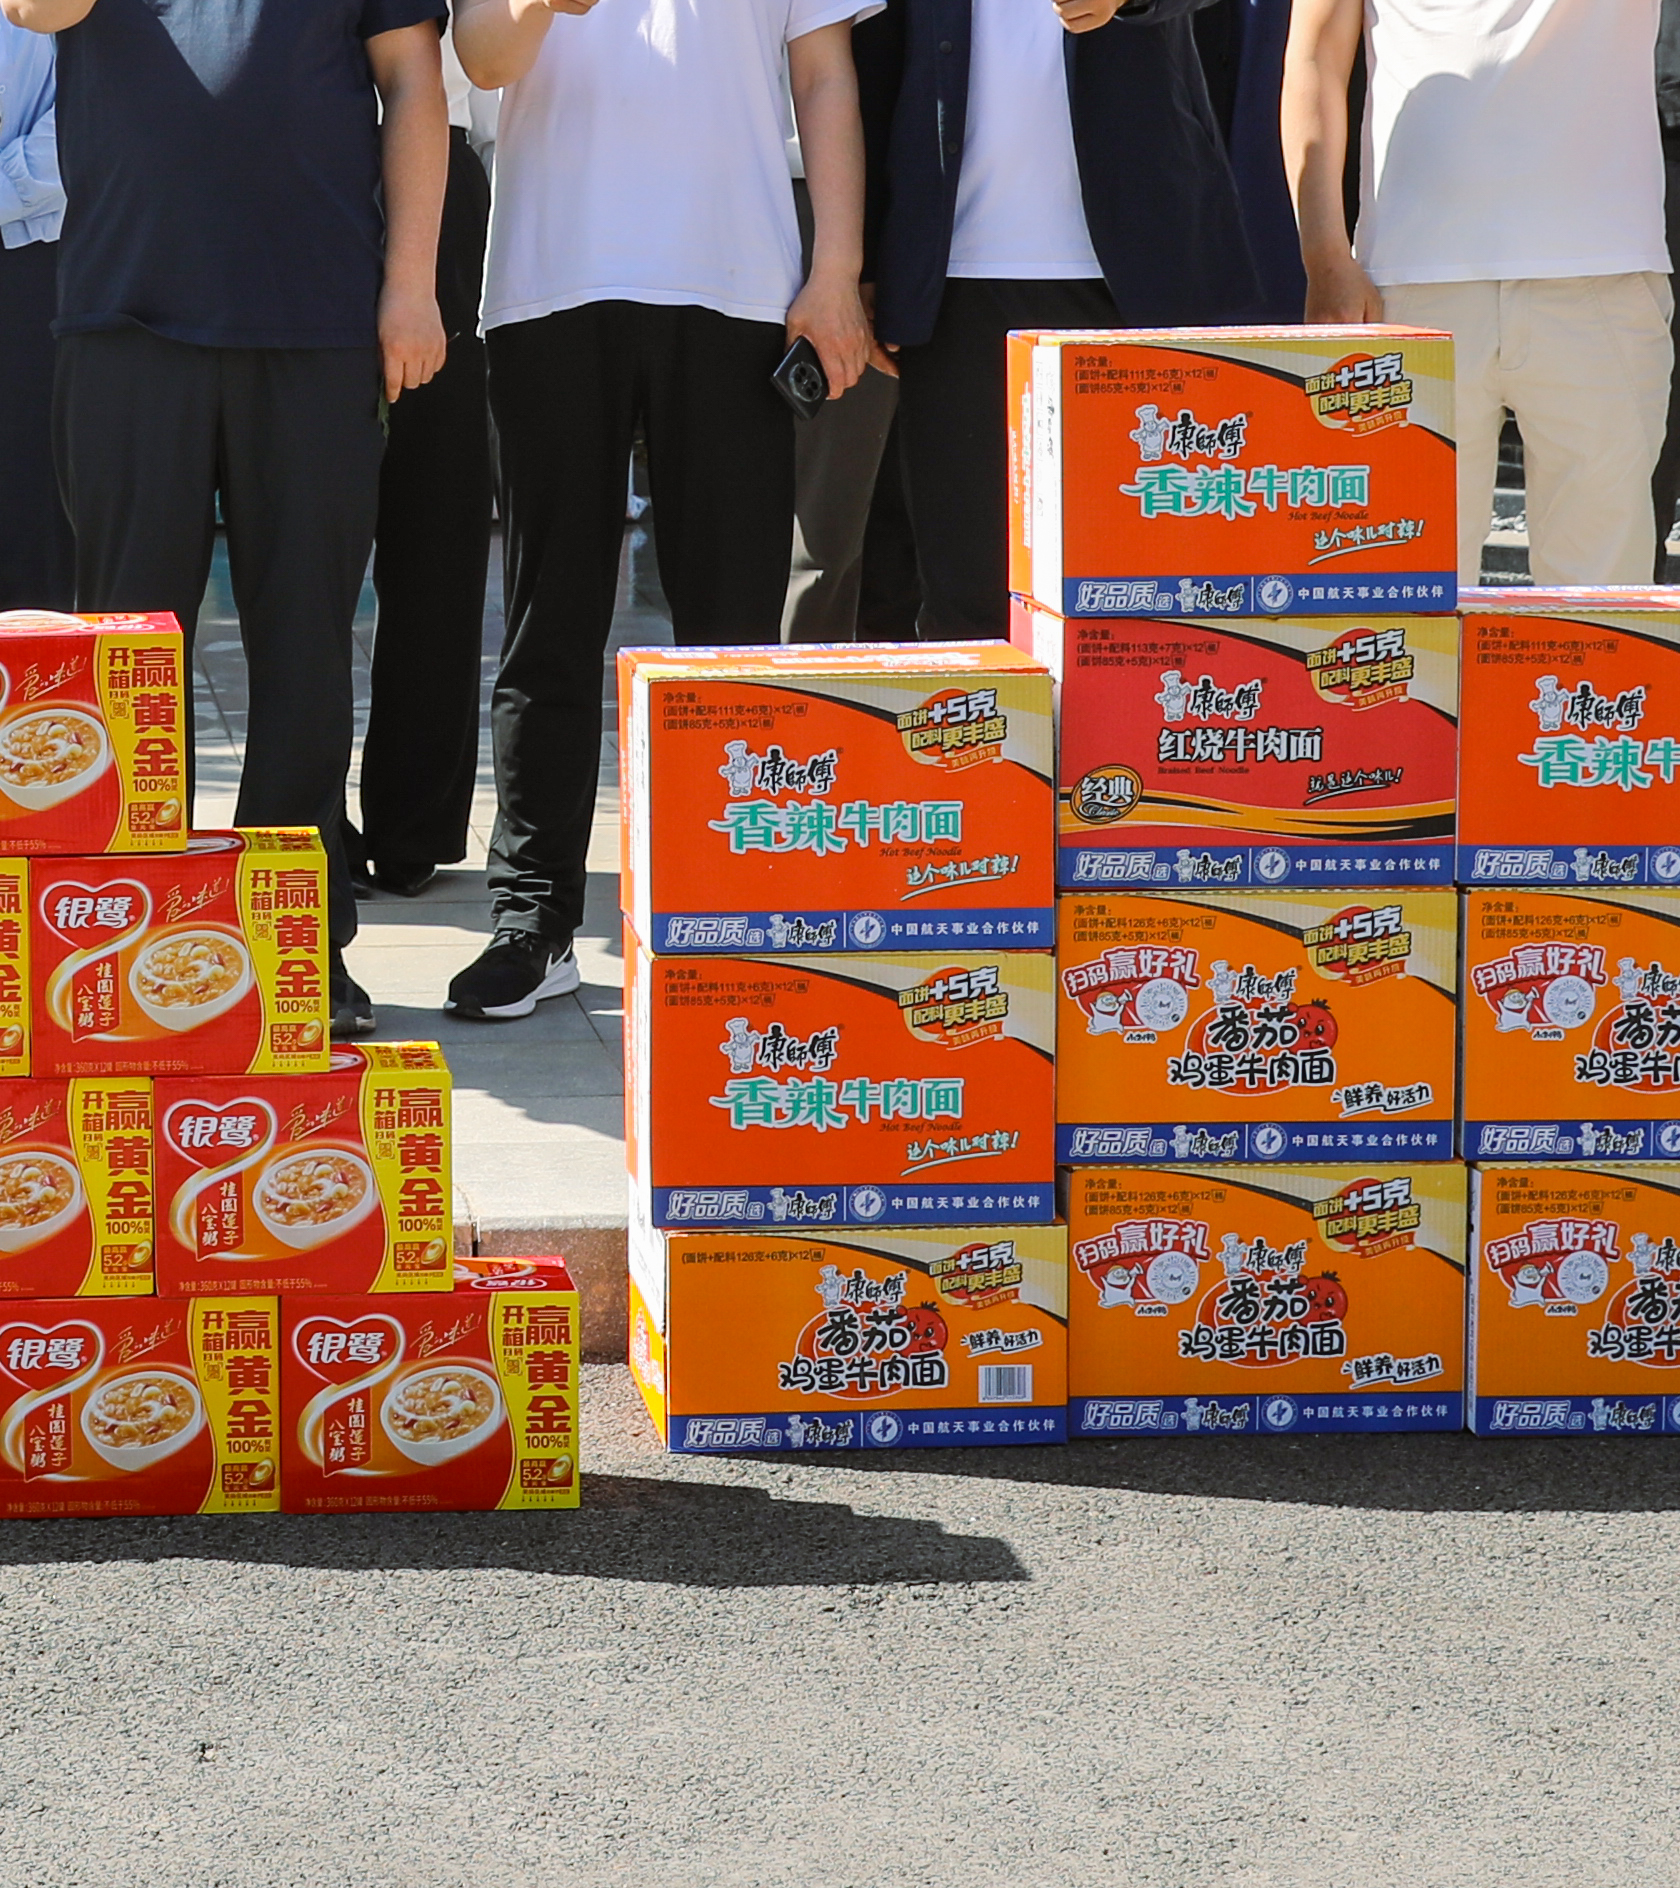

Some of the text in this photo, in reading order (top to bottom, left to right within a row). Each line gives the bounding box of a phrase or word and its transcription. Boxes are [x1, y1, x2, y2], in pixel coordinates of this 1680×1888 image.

[1120, 464, 1369, 519] 香辣牛肉面
[1297, 586, 1444, 600] 中国航天事业合作伙伴
[108, 648, 129, 689] 开箱
[131, 646, 178, 778] 赢黄金
[1157, 727, 1322, 763] 红烧牛肉面
[133, 778, 170, 792] 100%
[1080, 775, 1134, 806] 经典
[708, 799, 964, 856] 香辣牛肉面
[1295, 858, 1440, 872] 中国航天事业合作伙伴
[54, 897, 135, 933] 银鹭
[668, 917, 747, 948] 好品质
[891, 923, 1039, 937] 中国航天事业合作伙伴
[1066, 946, 1200, 996] 扫码赢好礼
[1474, 945, 1607, 994] 扫码赢好礼
[1208, 1005, 1299, 1050] 番茄
[1169, 1050, 1336, 1089] 鸡蛋牛肉面
[708, 1076, 965, 1132] 香辣牛肉面
[178, 1114, 258, 1150] 银鹭
[1291, 1133, 1438, 1148] 中国航天事业合作伙伴
[891, 1196, 1040, 1210] 中国航天事业合作伙伴
[1218, 1277, 1309, 1324] 番茄
[817, 1309, 910, 1356] 番茄
[1180, 1322, 1346, 1361] 鸡蛋牛肉面
[7, 1338, 88, 1373] 银鹭
[524, 1305, 571, 1434] 赢黄金
[778, 1355, 947, 1394] 鸡蛋牛肉面
